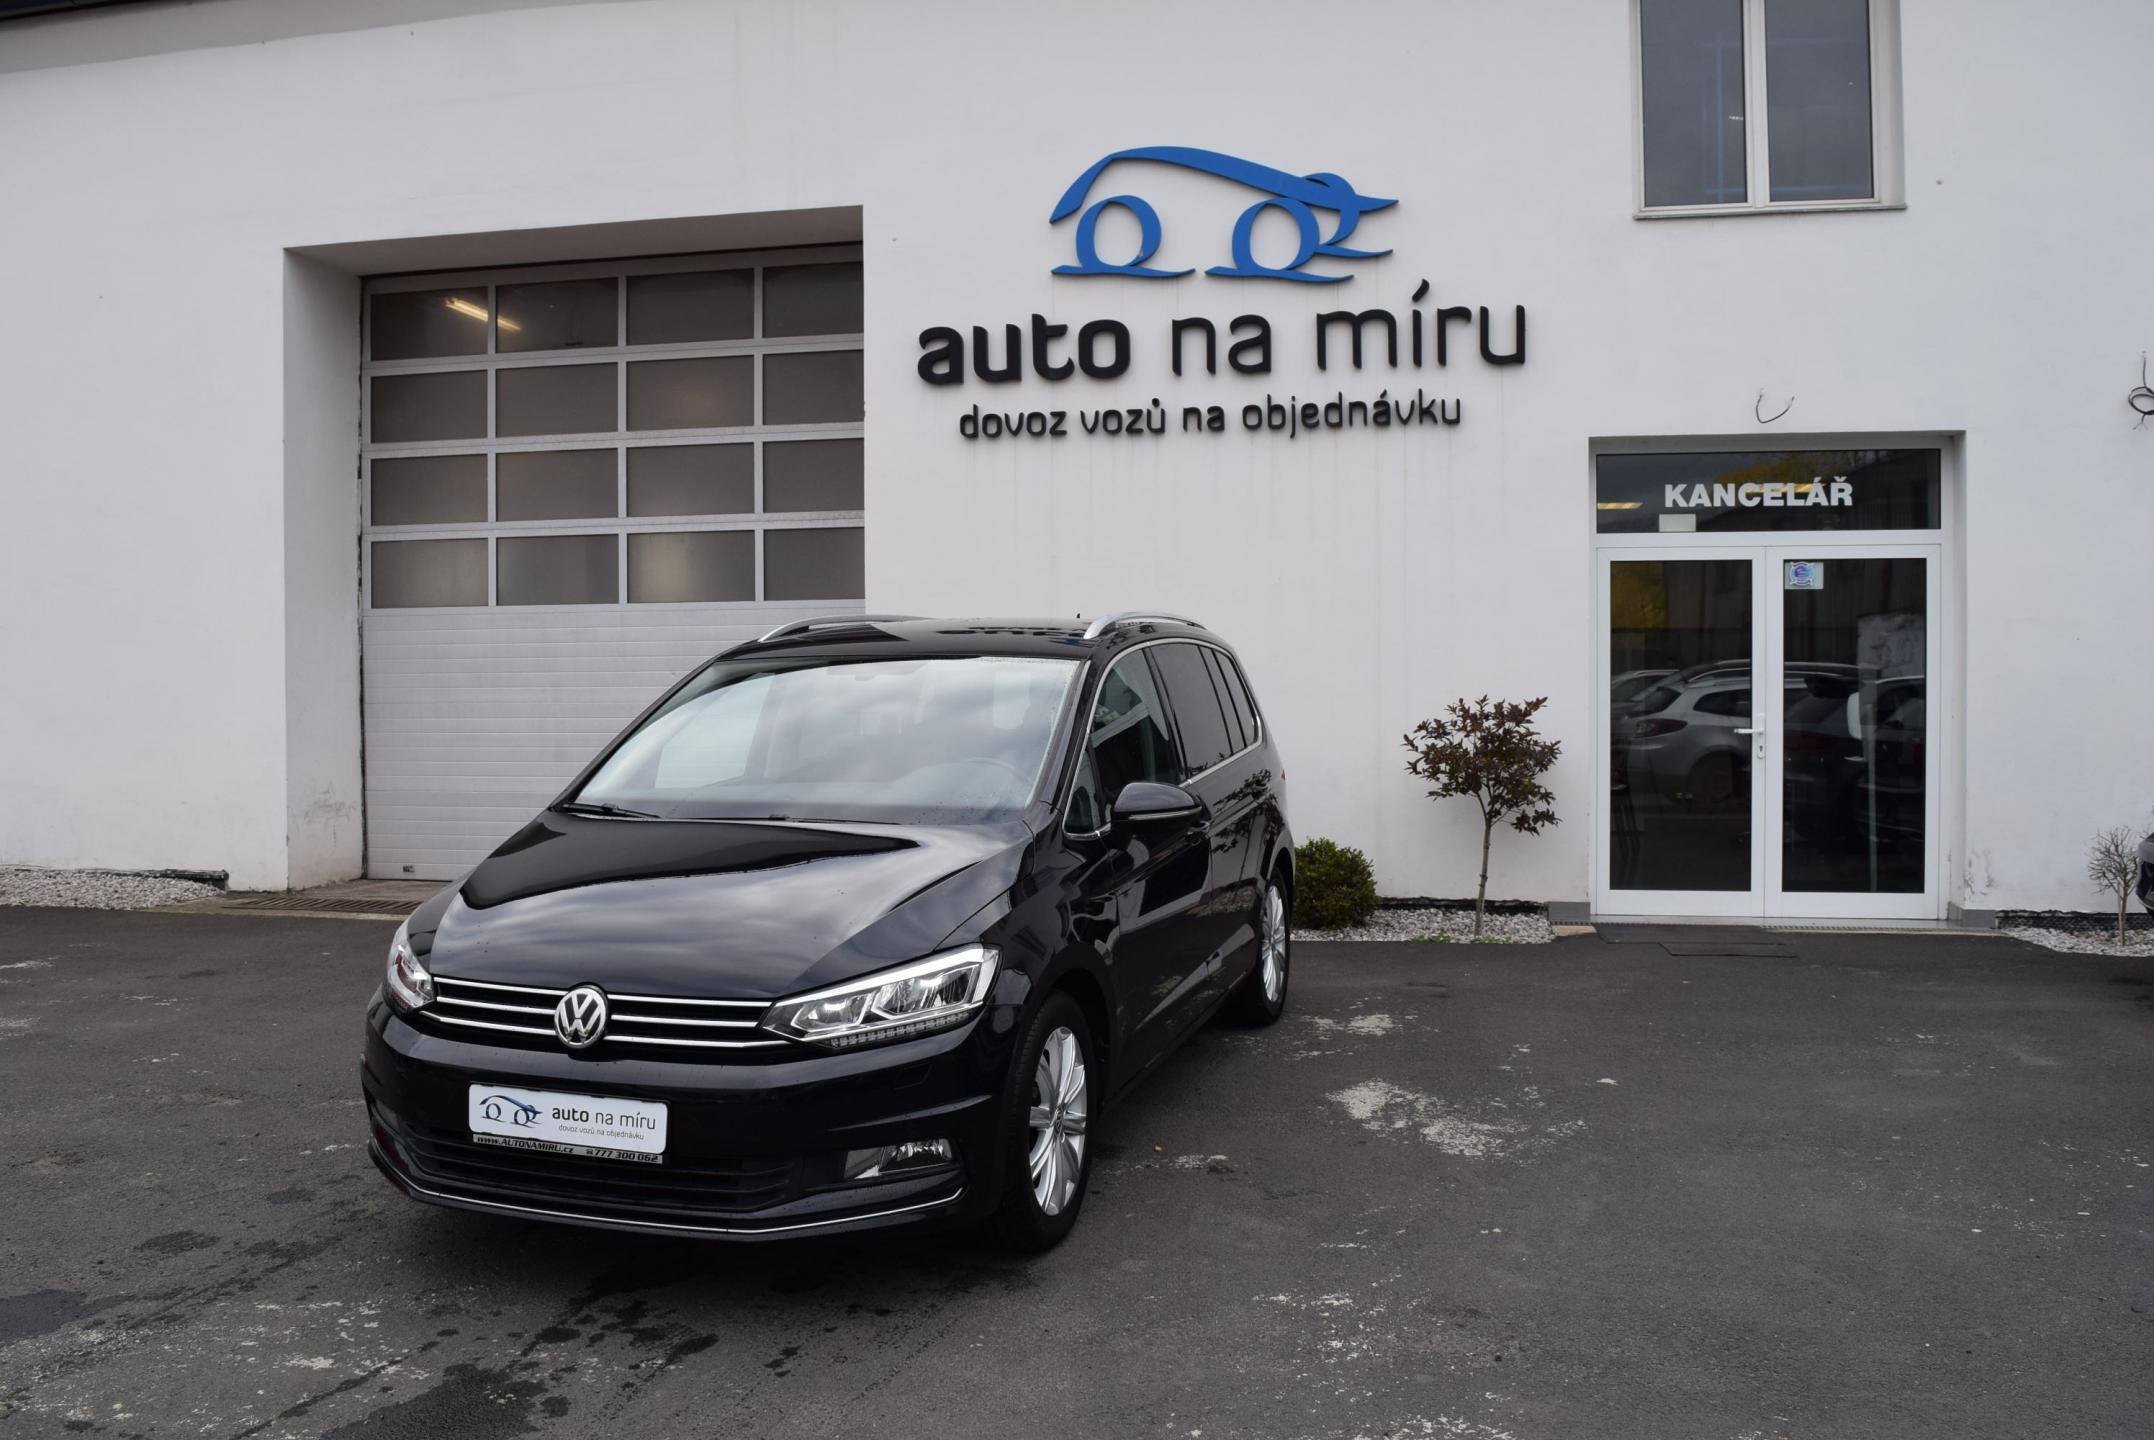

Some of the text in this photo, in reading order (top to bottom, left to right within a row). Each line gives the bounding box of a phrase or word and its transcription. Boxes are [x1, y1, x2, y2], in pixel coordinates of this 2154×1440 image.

[917, 278, 1527, 389] auto na míru
[959, 388, 1462, 442] dovoz vozů na objednávku
[1664, 476, 1854, 508] KANCELÁŘ
[552, 1107, 656, 1130] auto na míru
[558, 1124, 578, 1133] dovoz
[579, 1126, 595, 1135] vozů
[606, 1130, 645, 1140] objednávku
[615, 1151, 636, 1160] 300
